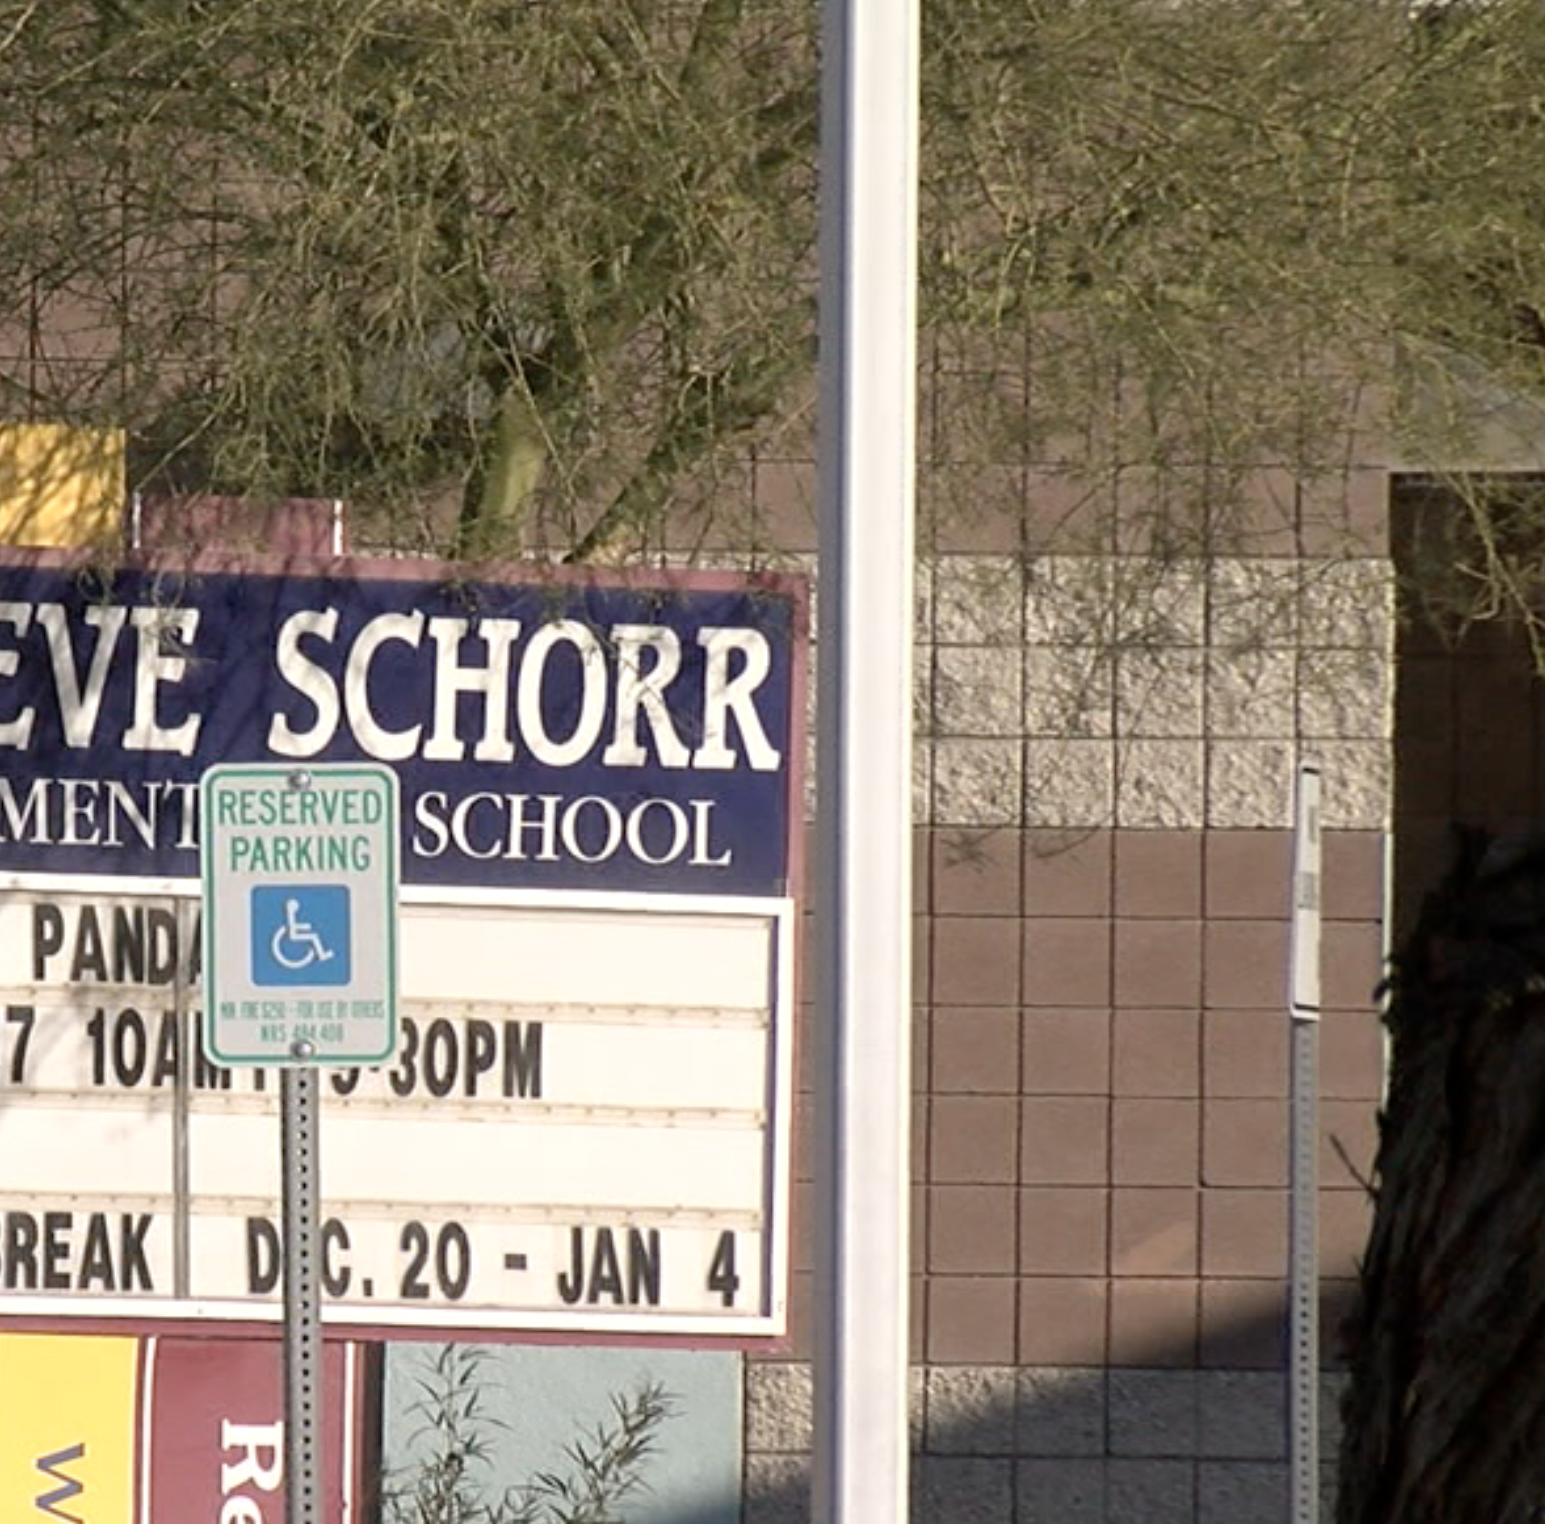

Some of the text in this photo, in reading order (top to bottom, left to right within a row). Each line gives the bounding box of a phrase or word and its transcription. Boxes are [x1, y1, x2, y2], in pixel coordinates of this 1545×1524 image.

[267, 606, 782, 772] SCHORR
[218, 789, 383, 826] RESERVED
[412, 792, 732, 866] SCHOOL
[230, 836, 372, 872] PARKING
[331, 1016, 544, 1100] 30PM
[247, 1216, 375, 1298] DC.
[399, 1220, 471, 1301] 20
[504, 1253, 528, 1270] -
[557, 1226, 662, 1306] JAN
[707, 1229, 740, 1308] 4
